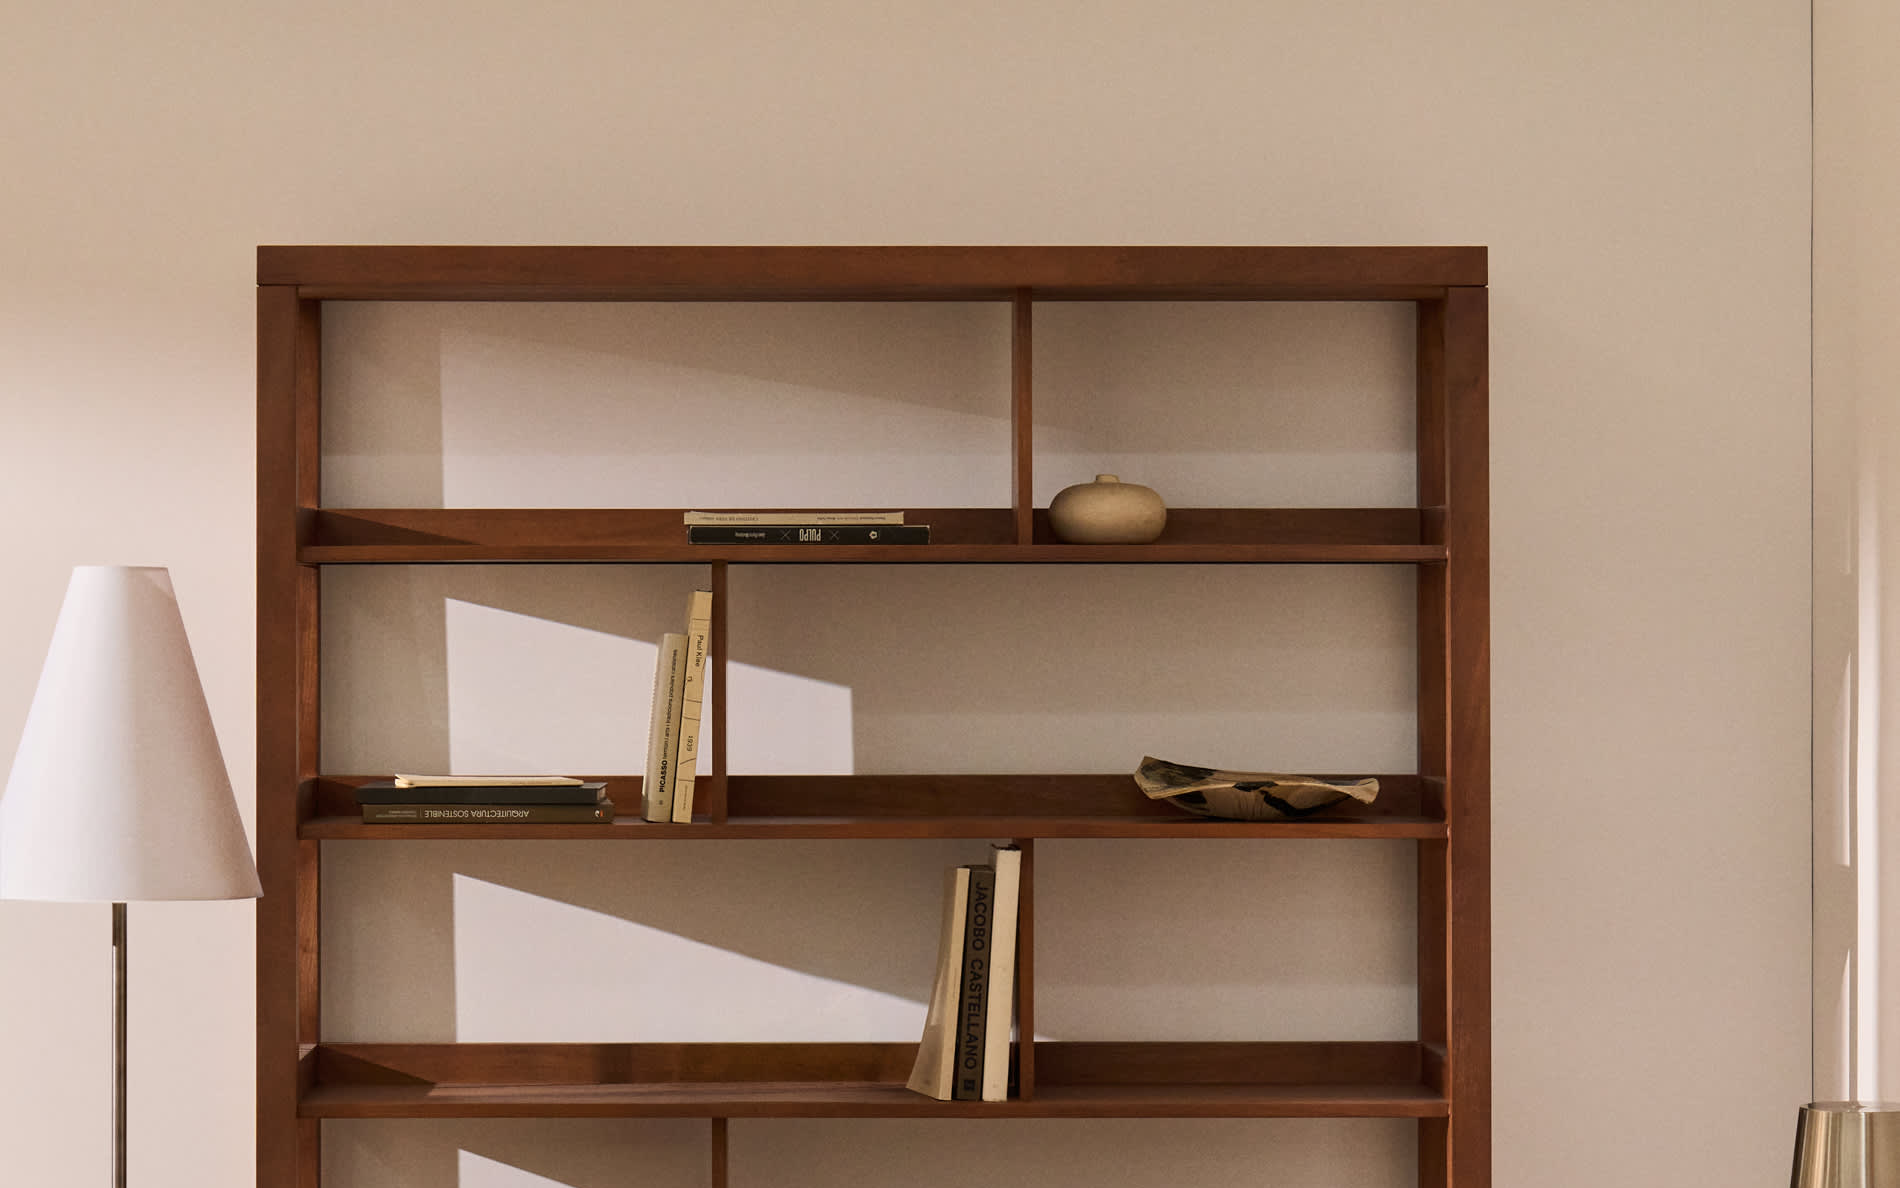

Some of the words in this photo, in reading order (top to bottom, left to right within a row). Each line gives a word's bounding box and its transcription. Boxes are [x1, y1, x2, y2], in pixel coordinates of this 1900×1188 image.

[799, 528, 821, 542] PULPO
[659, 760, 668, 793] PICASSO
[424, 809, 469, 818] SOSTENIBLE
[470, 809, 530, 818] ARQUITECTURA
[972, 882, 988, 951] JACOBO
[964, 959, 983, 1070] CASTELLANO
